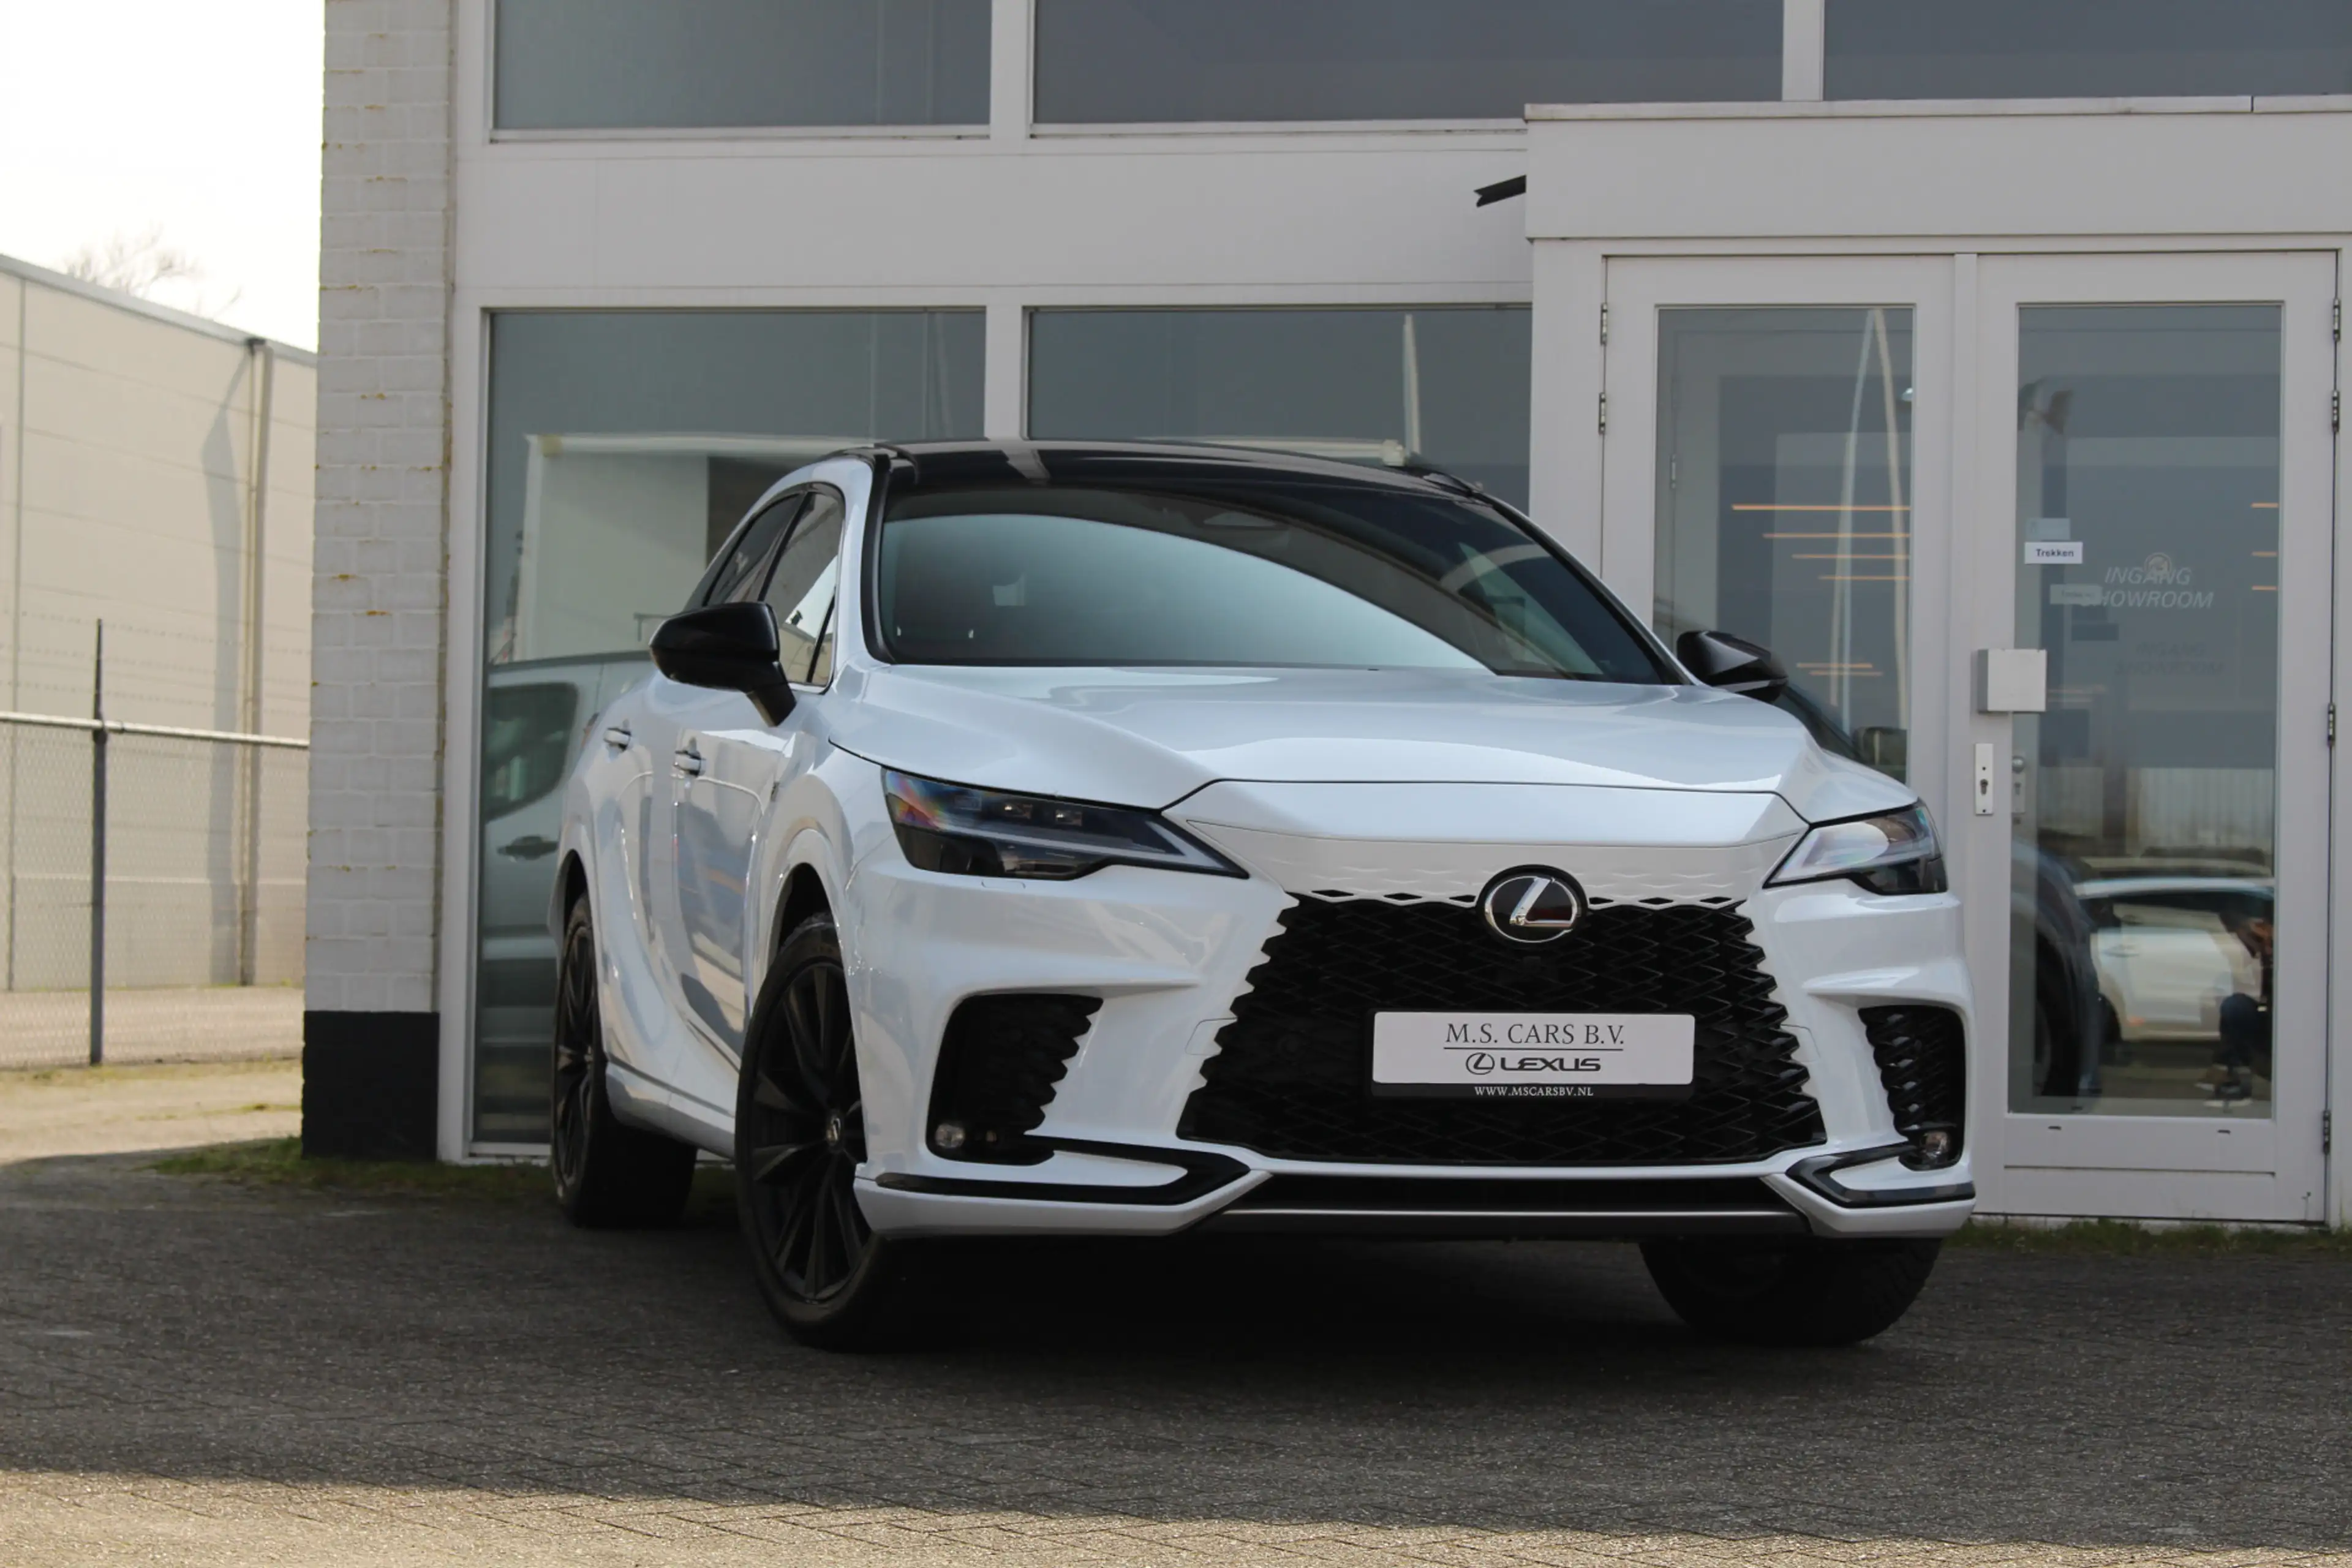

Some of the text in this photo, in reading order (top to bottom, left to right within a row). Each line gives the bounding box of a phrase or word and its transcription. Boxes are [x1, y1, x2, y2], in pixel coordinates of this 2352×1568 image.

[2036, 548, 2075, 557] Trekken
[2105, 566, 2192, 585] INGANG
[2080, 590, 2214, 609] HOWROOM
[1445, 1023, 1625, 1045] M.S. CARS B.V.
[1500, 1057, 1601, 1072] LEXUS
[1474, 1085, 1594, 1097] WWW.MSCARSBV.NL
